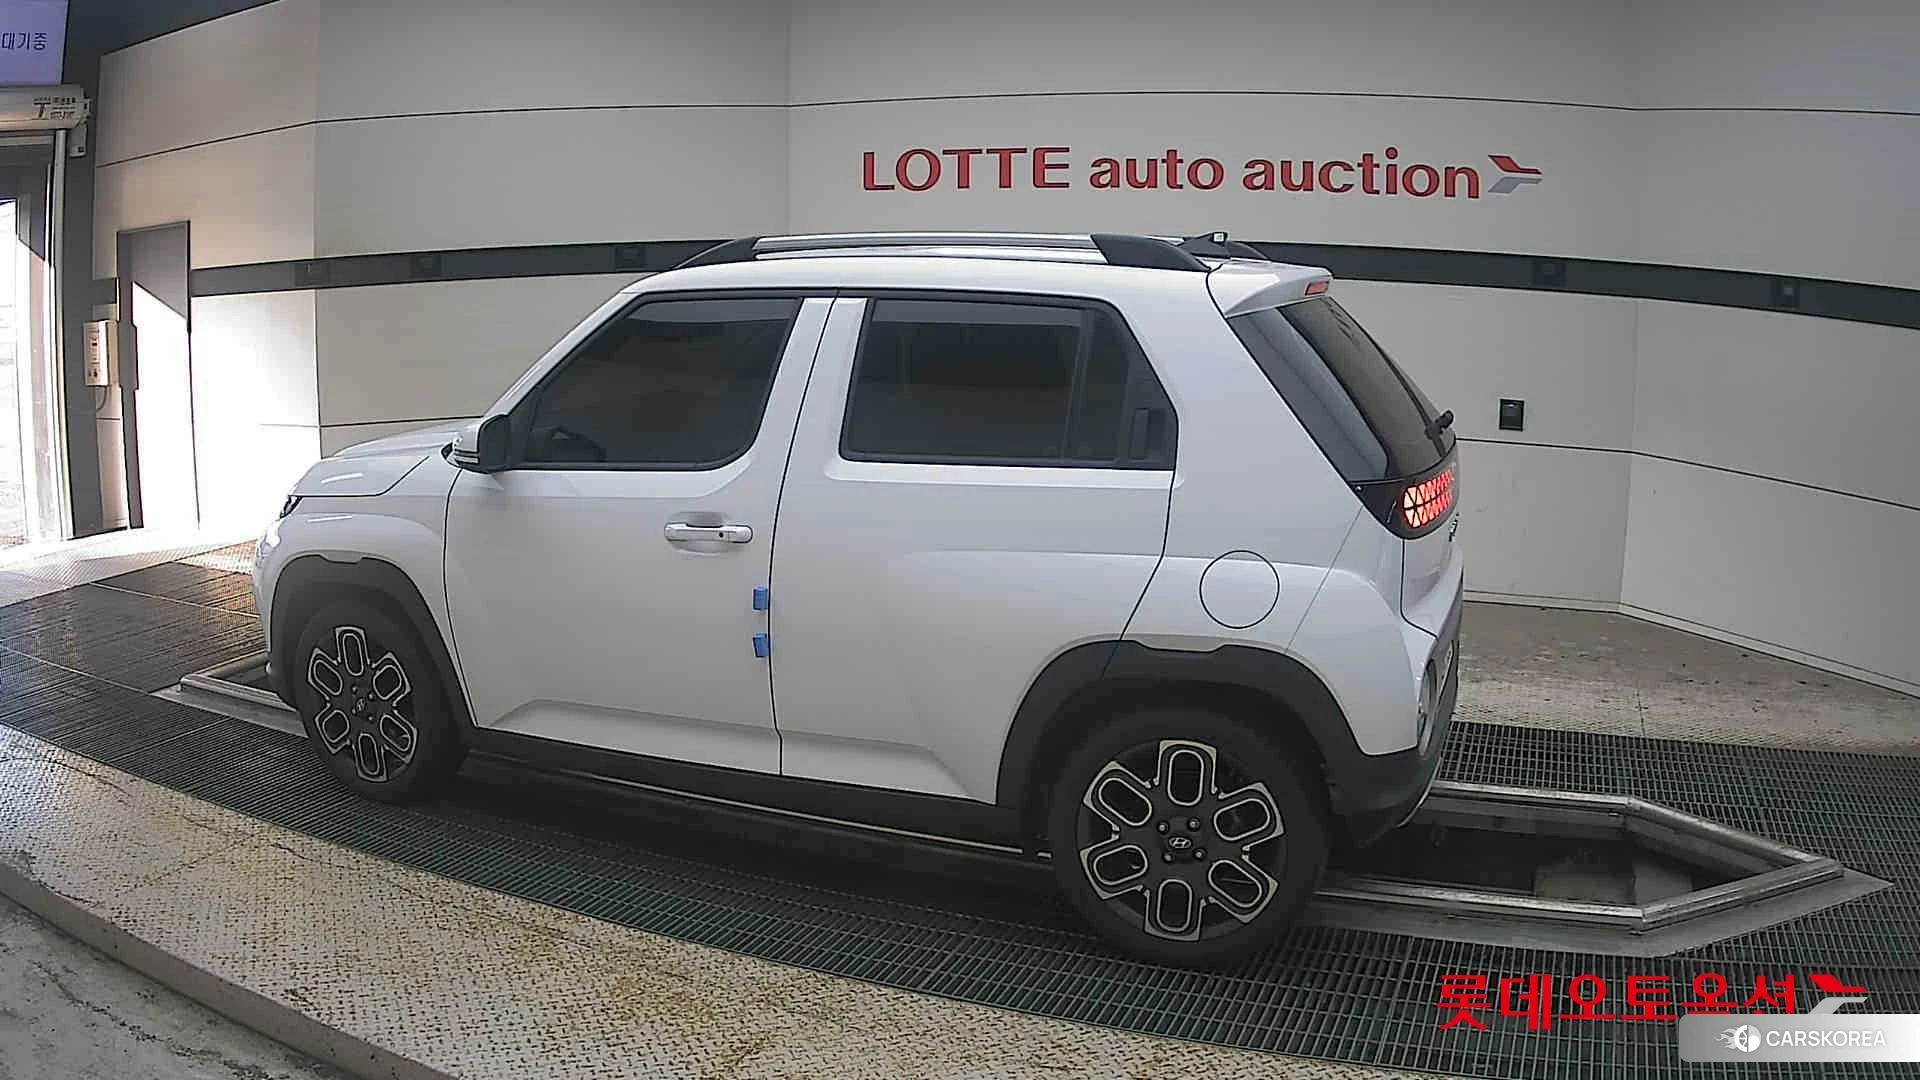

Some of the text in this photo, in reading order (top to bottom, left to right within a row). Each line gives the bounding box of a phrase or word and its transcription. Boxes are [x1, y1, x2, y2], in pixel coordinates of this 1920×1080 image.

[1, 32, 48, 51] 대기중
[863, 147, 1481, 198] LOTTE auto auction
